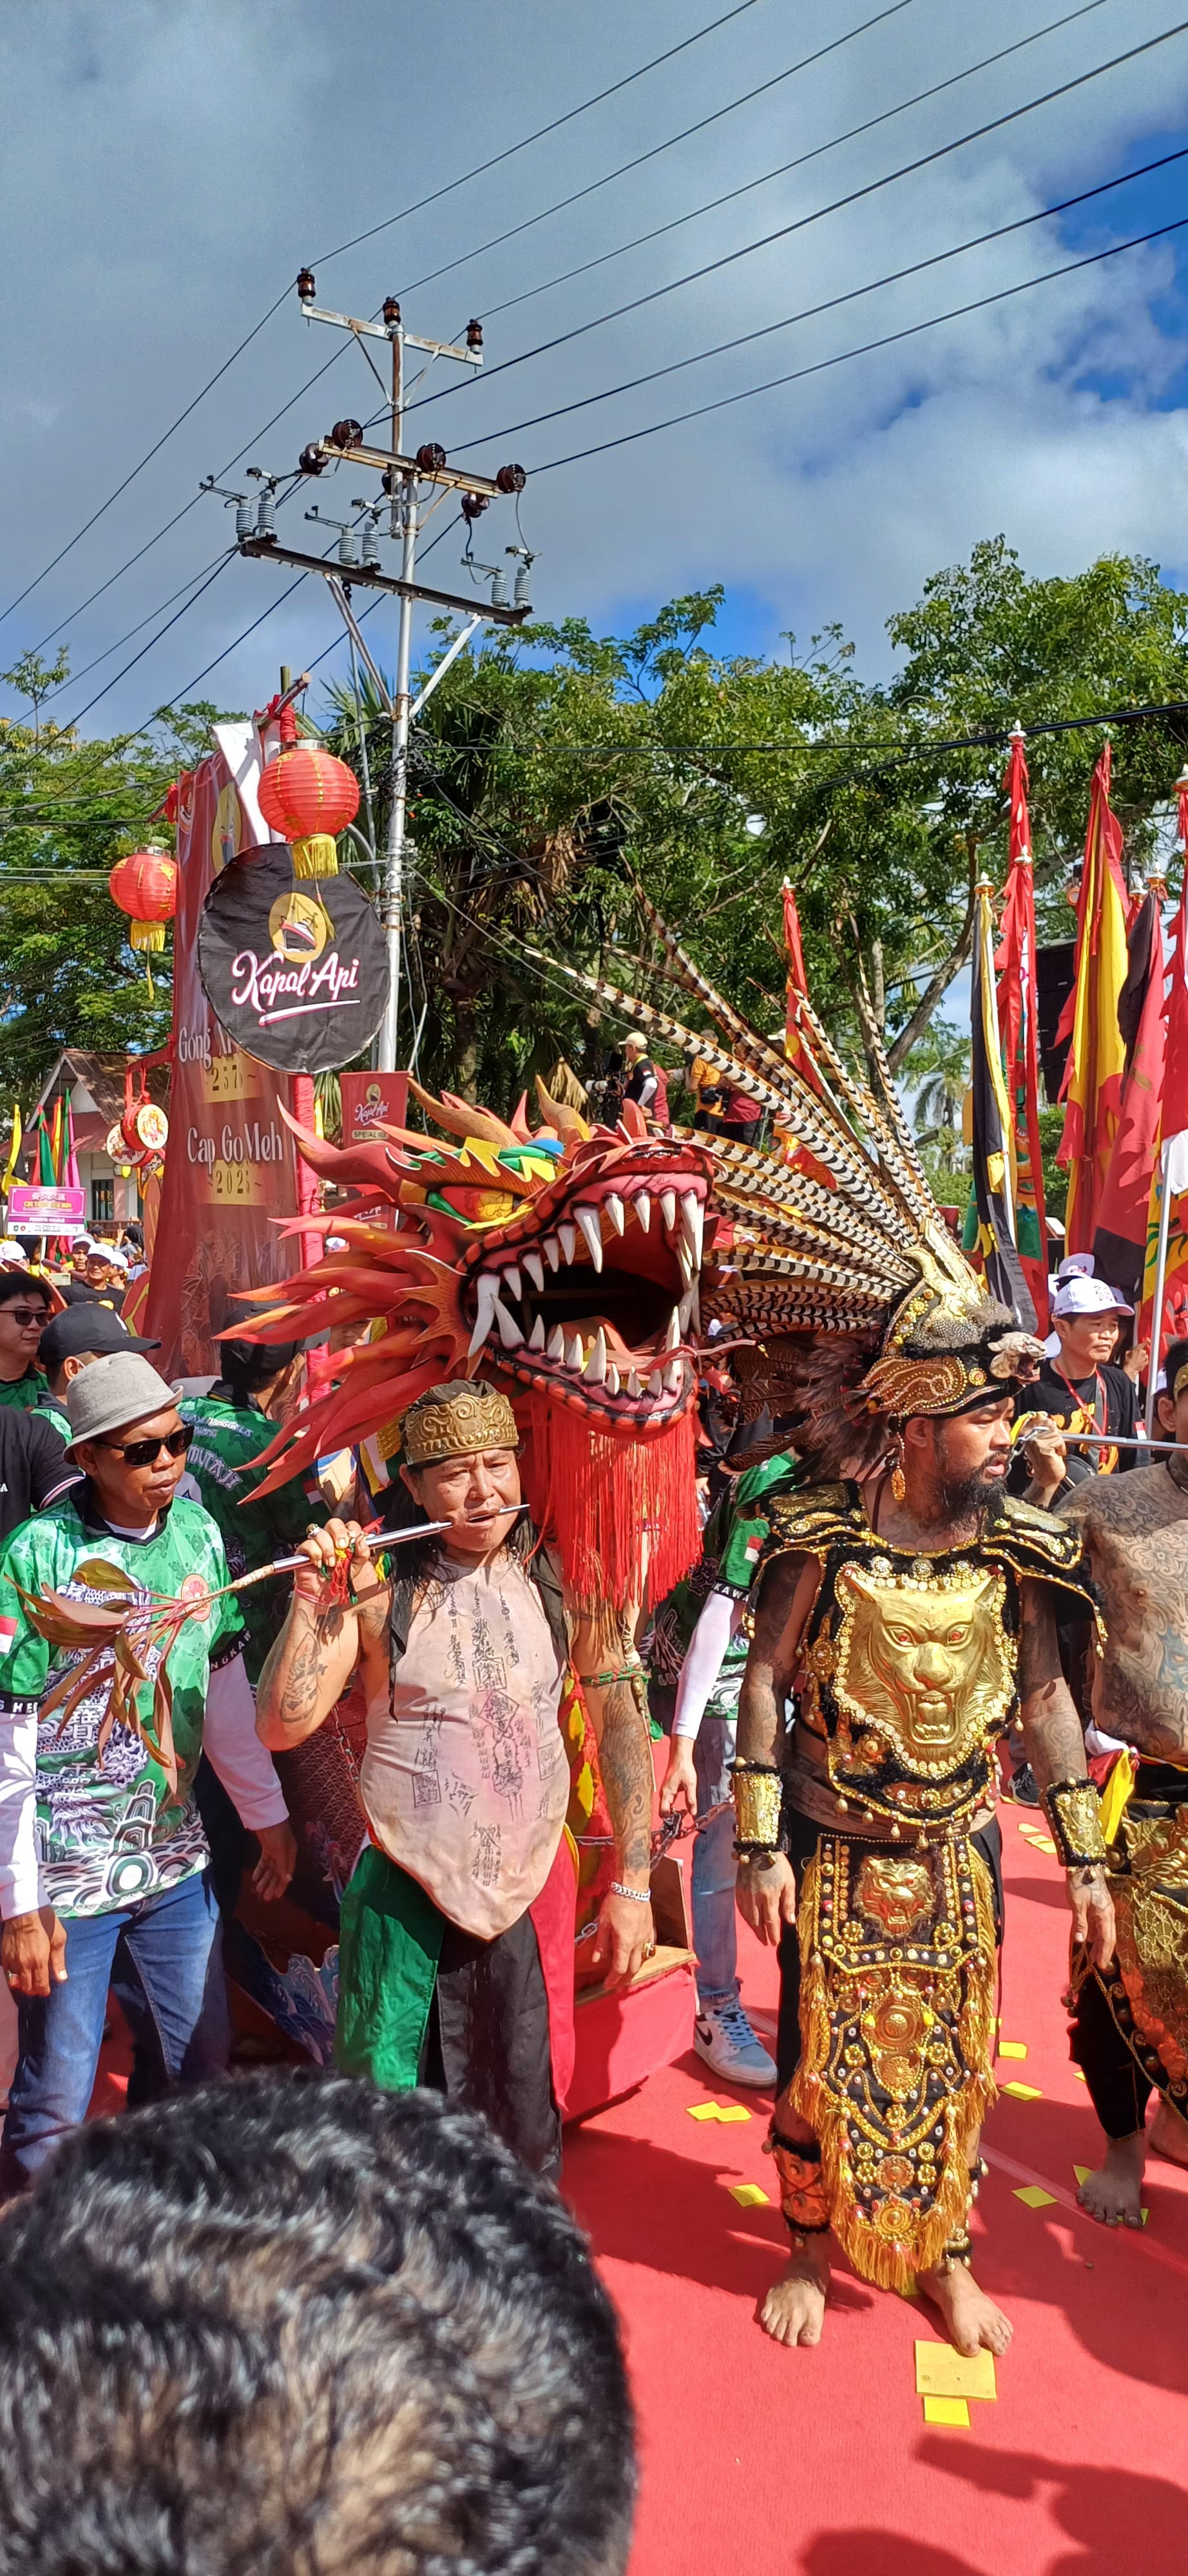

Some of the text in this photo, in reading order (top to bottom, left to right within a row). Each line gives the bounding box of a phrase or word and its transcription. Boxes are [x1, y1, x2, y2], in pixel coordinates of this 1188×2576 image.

[231, 950, 359, 1012] Kapal Api
[178, 1027, 211, 1069] Gong
[187, 1121, 283, 1174] Cap Go Meh
[211, 1627, 252, 1671] NGKAW
